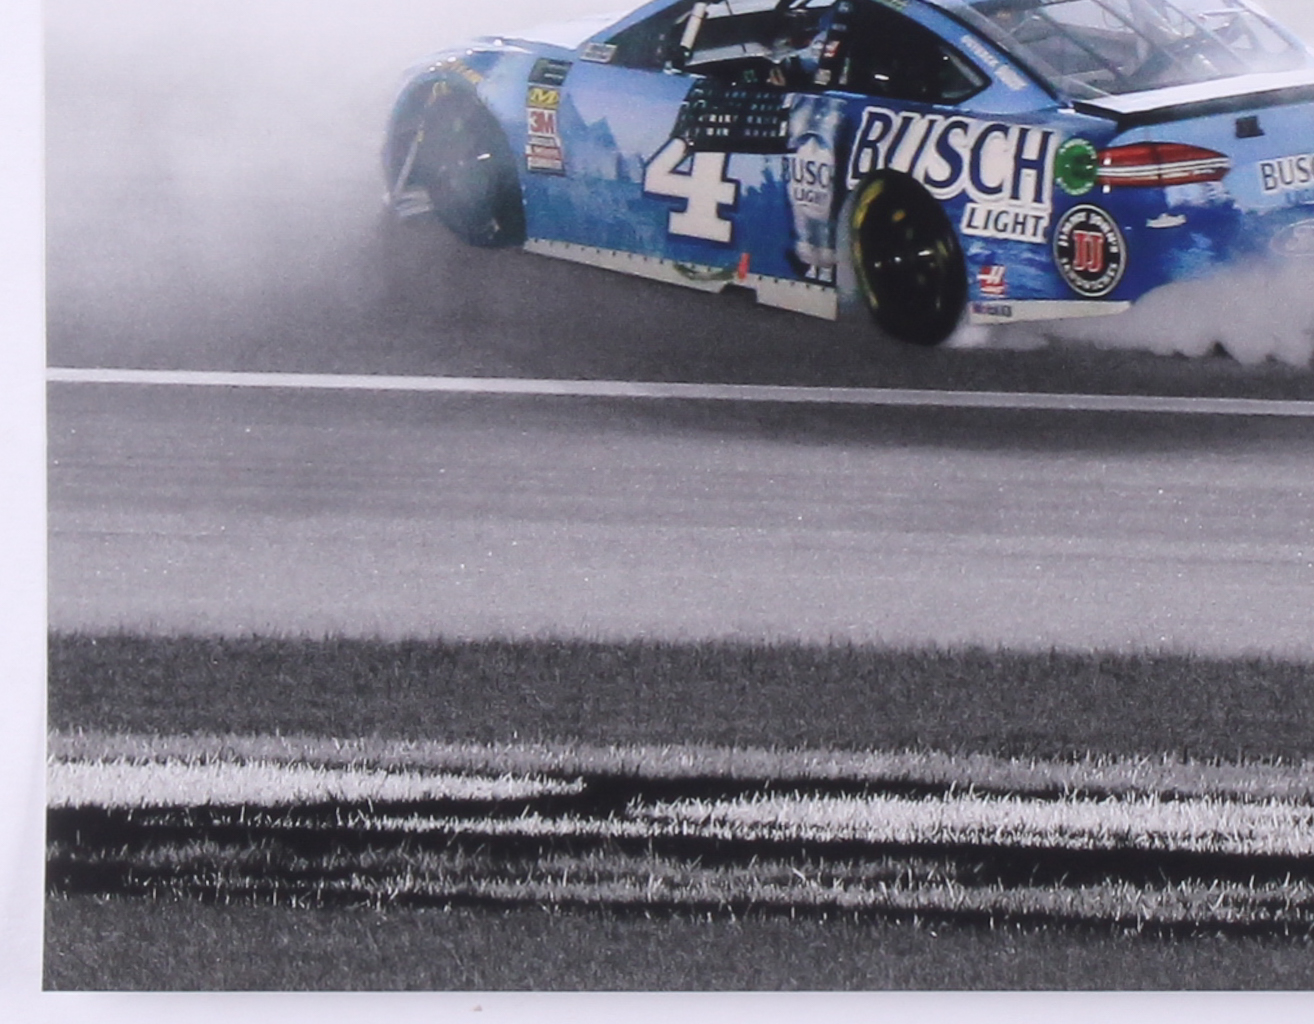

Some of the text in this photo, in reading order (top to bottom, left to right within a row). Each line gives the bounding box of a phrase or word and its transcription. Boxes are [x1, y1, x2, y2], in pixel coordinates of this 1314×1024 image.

[530, 110, 555, 135] 3M
[781, 156, 832, 188] BUSC
[852, 110, 1055, 204] BUSCH
[643, 137, 736, 243] 4
[966, 207, 1046, 238] LIGHT
